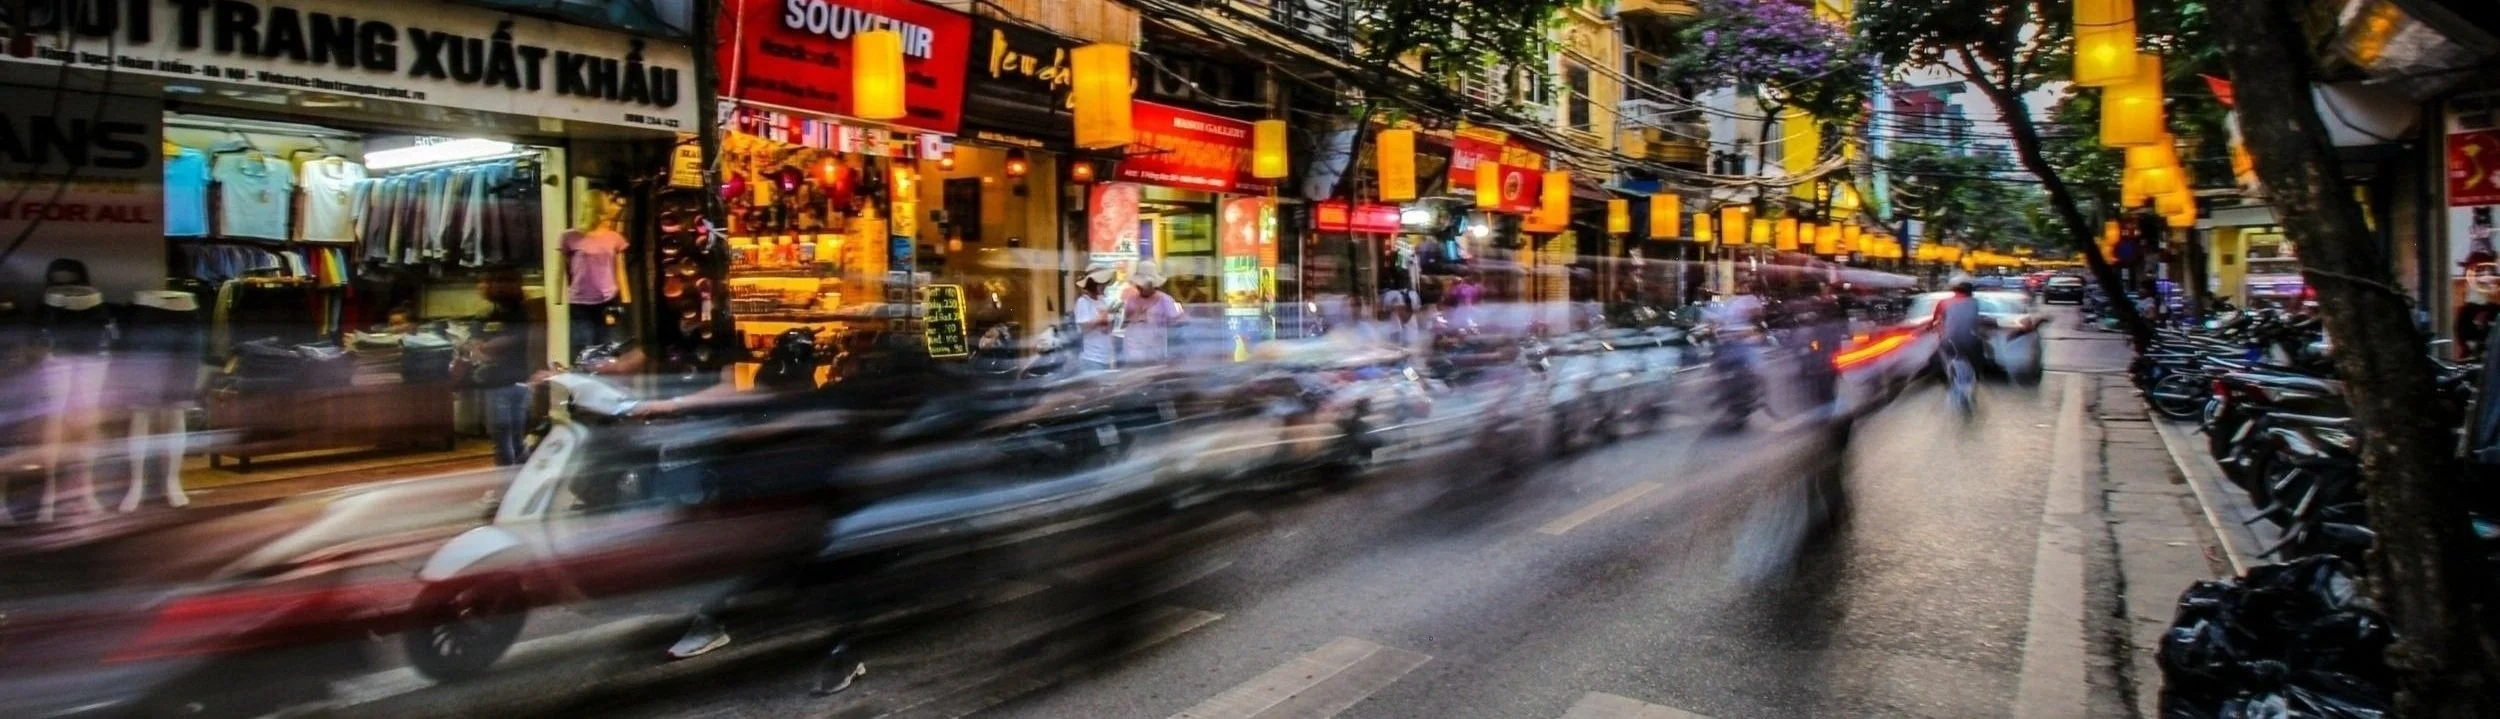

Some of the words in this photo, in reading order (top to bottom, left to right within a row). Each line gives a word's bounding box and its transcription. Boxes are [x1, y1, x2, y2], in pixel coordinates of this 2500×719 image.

[167, 0, 398, 71] TRANG
[406, 20, 548, 91] XUẤT
[555, 38, 679, 108] KHẨU
[1206, 123, 1247, 140] GALLERY
[20, 202, 90, 222] FOR
[96, 204, 153, 224] ALL
